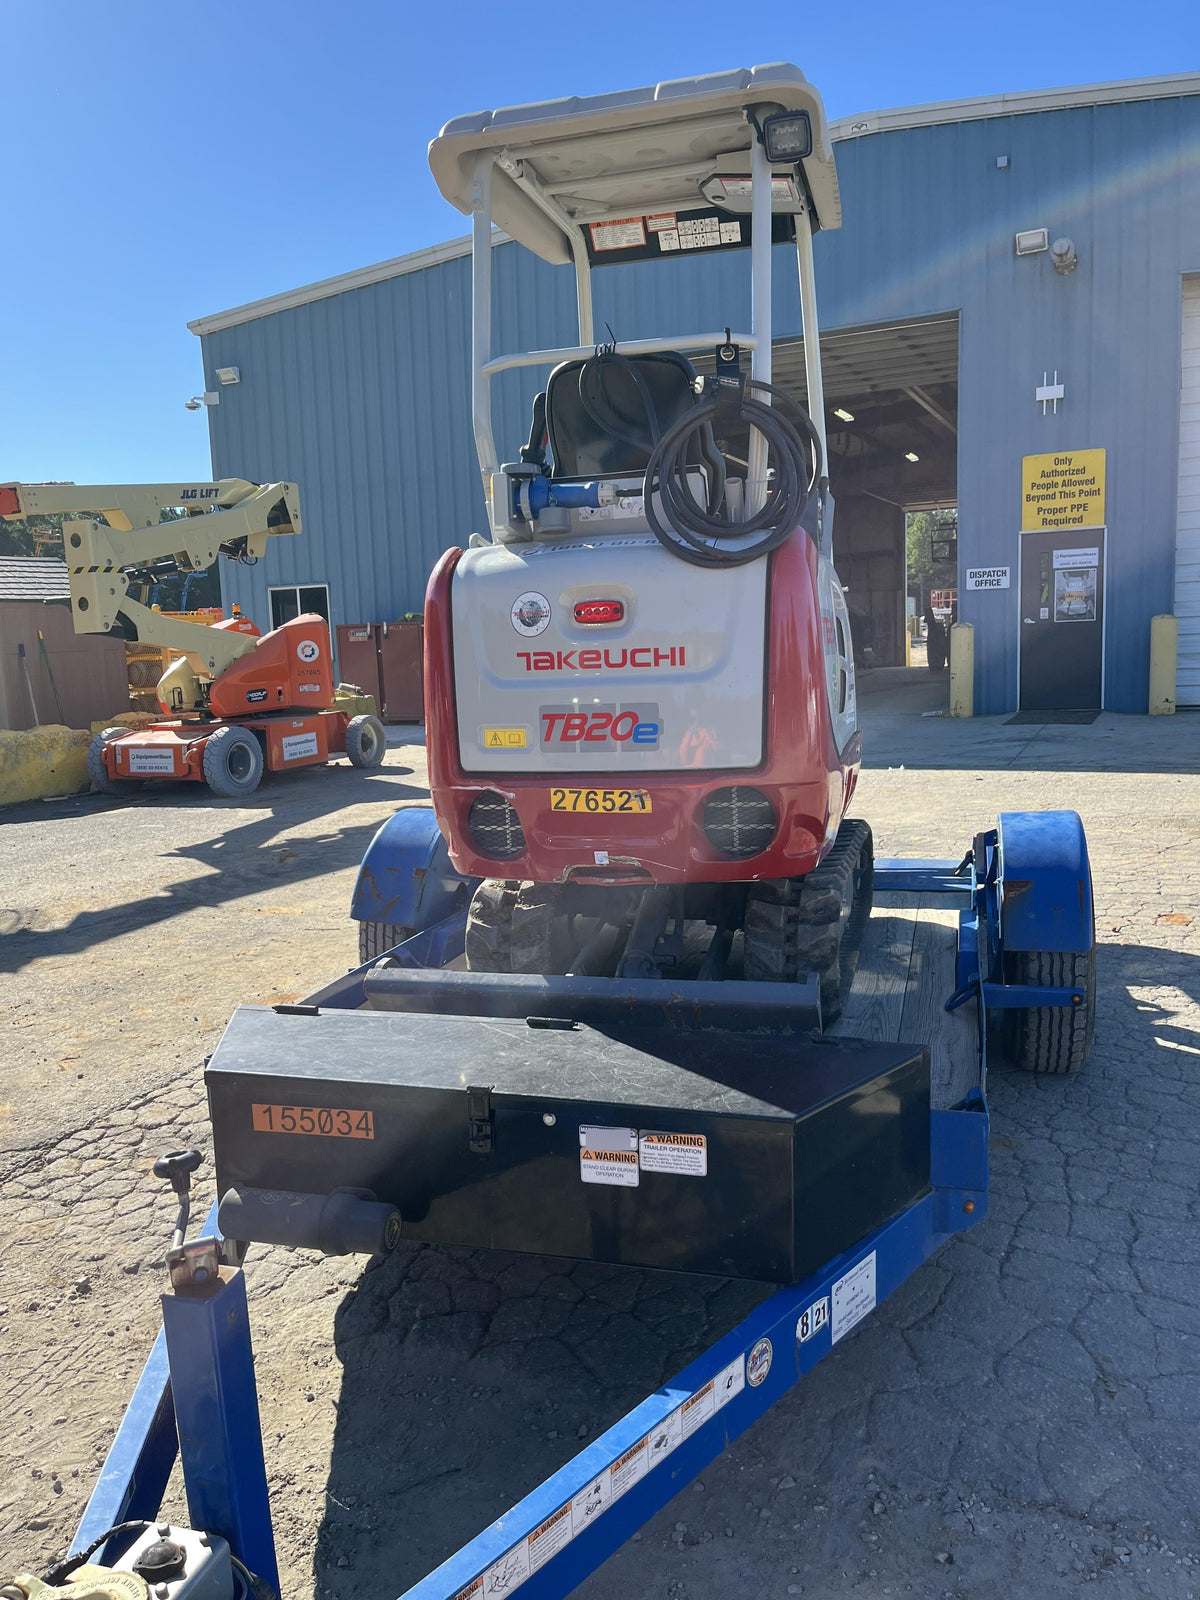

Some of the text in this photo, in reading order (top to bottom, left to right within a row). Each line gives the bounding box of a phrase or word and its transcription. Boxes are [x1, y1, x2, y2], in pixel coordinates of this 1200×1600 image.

[1054, 456, 1073, 466] Only
[1040, 466, 1086, 478] Authorized
[1031, 476, 1096, 491] People Allowed
[180, 488, 219, 499] JLG LIFT
[1025, 488, 1101, 503] Beyond This Point
[1037, 503, 1089, 516] Proper PPE
[1041, 515, 1083, 527] Required
[969, 569, 1007, 579] DISPATCH
[974, 578, 1002, 588] OFFICE
[541, 711, 659, 744] TB20e
[552, 789, 646, 812] 276521
[262, 1105, 372, 1137] 155034
[656, 1135, 703, 1147] WARNING
[643, 1144, 702, 1155] TRAILER OPERATION
[594, 1151, 636, 1163] WARNING
[595, 1171, 624, 1179] OPERATION
[800, 1312, 809, 1338] 8
[815, 1302, 826, 1327] 21
[622, 1441, 645, 1464] WARNING
[540, 1506, 568, 1533] WARNING
